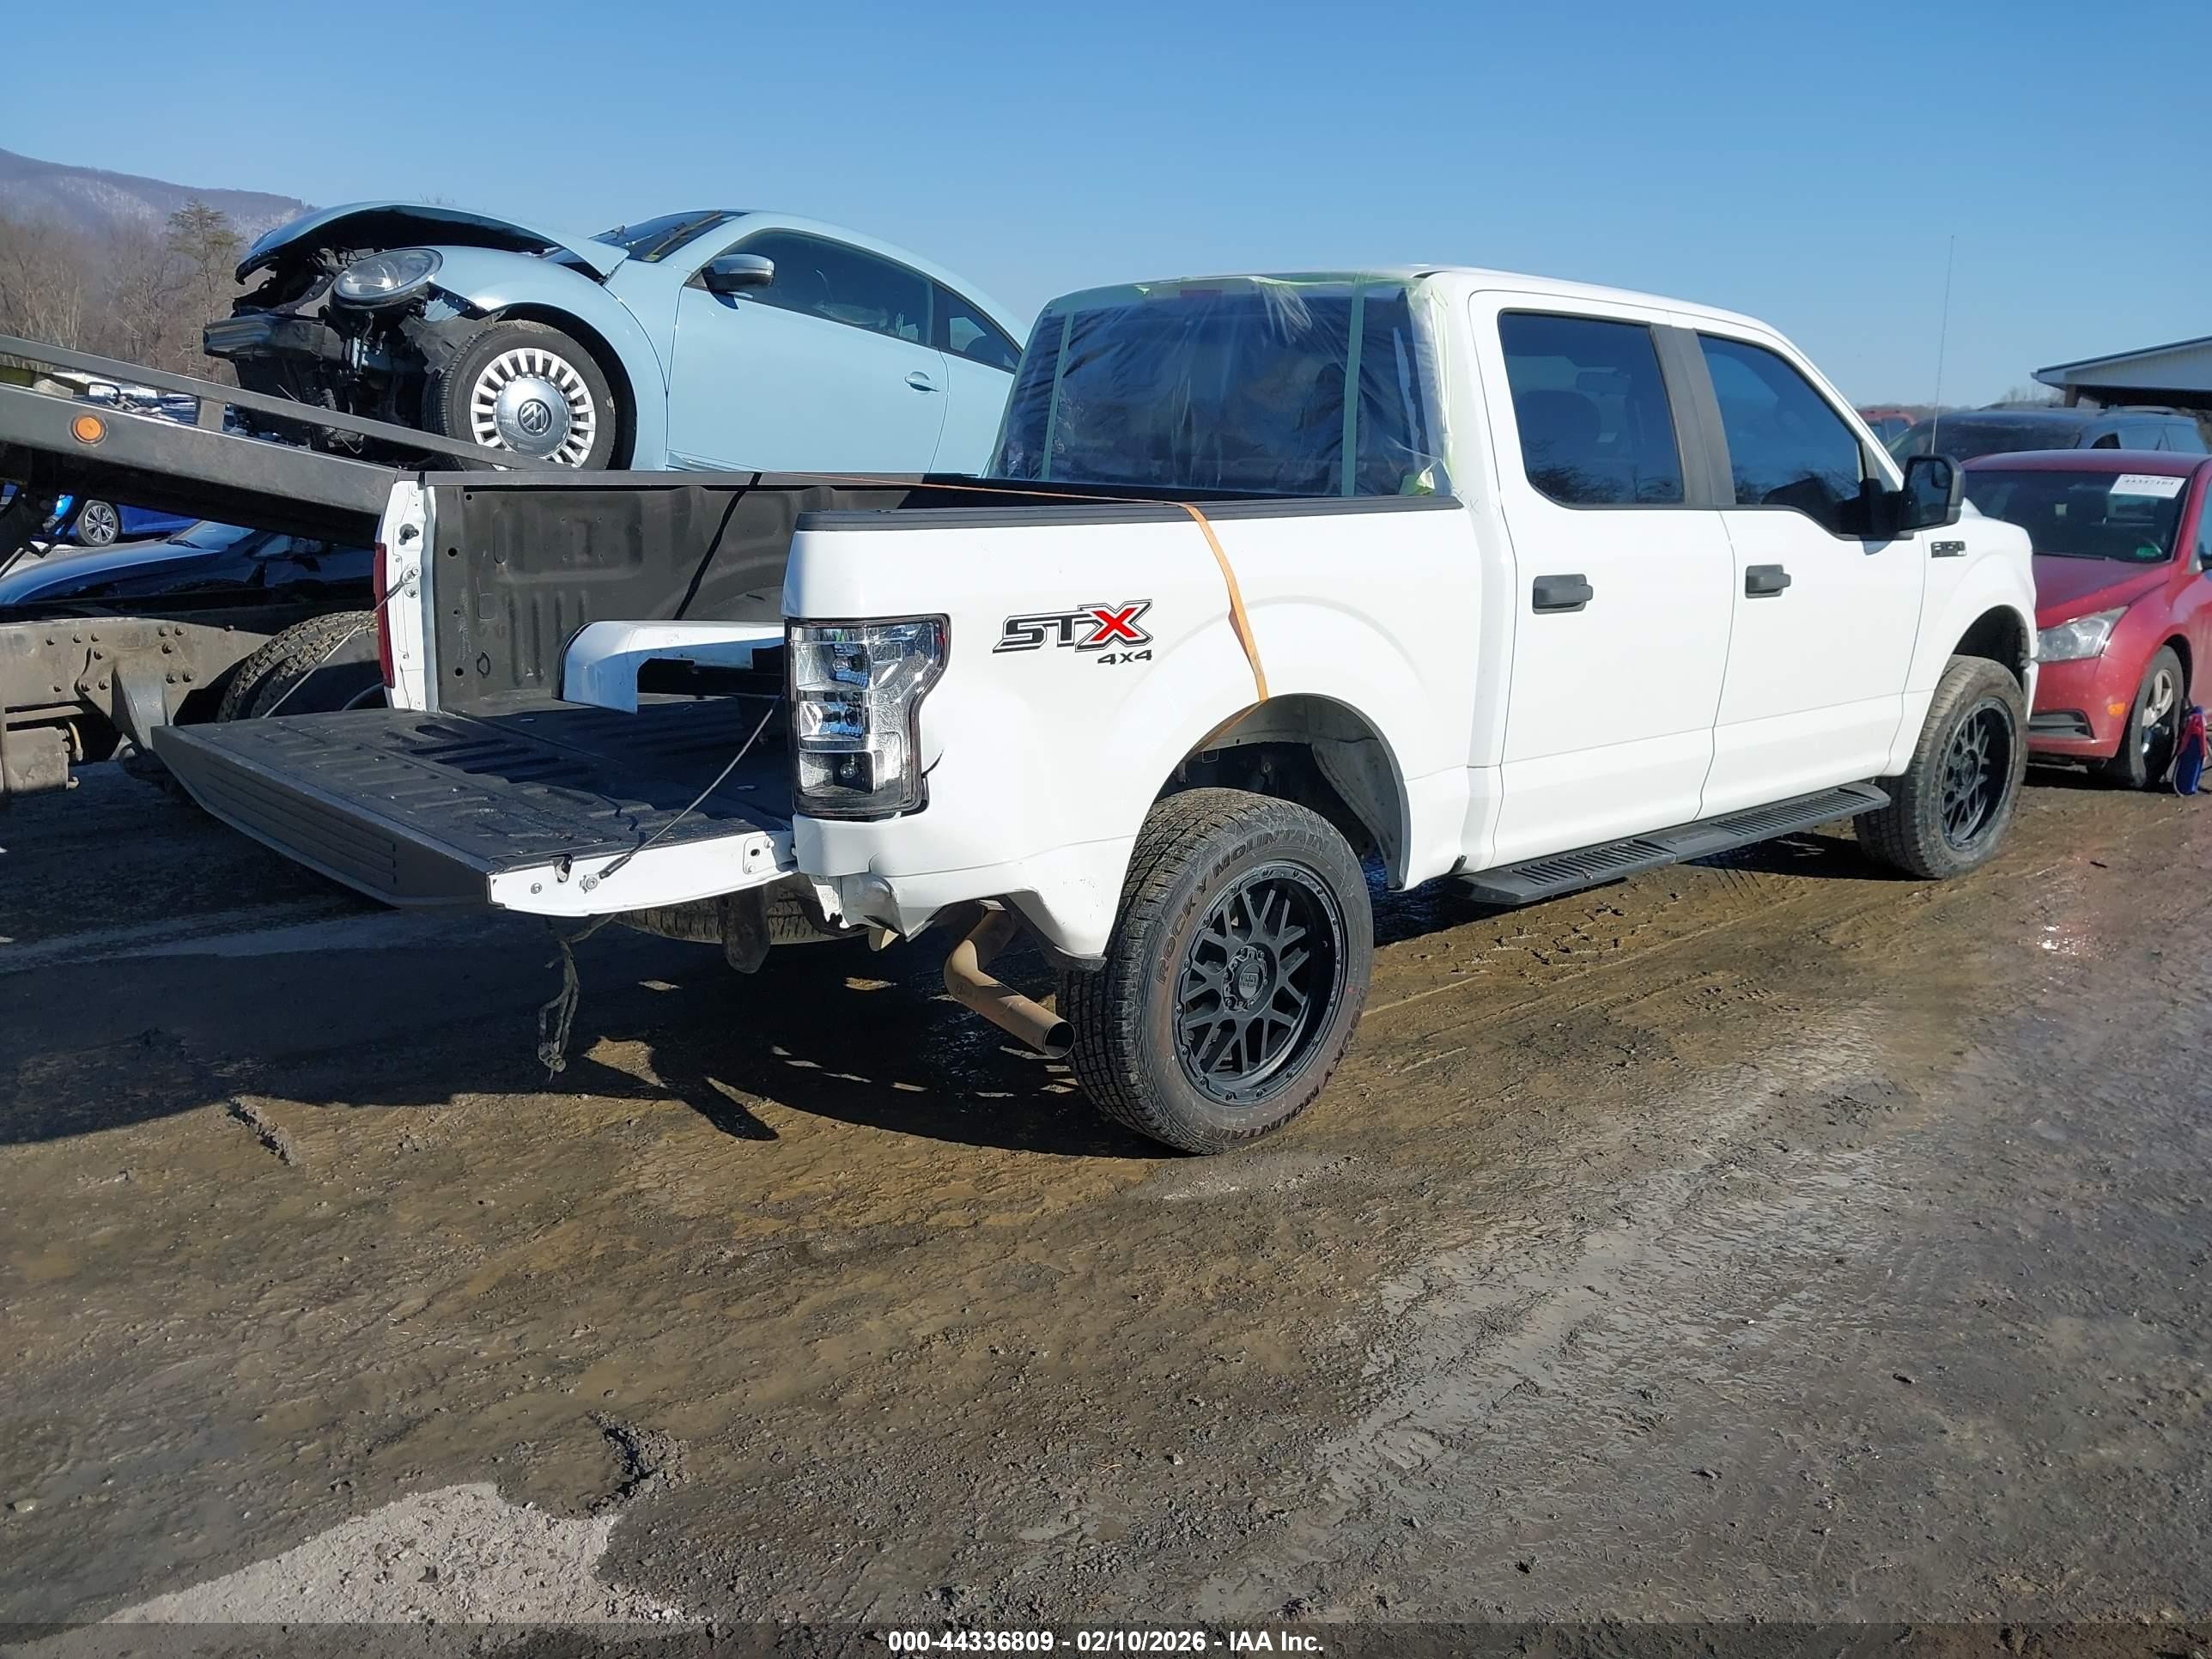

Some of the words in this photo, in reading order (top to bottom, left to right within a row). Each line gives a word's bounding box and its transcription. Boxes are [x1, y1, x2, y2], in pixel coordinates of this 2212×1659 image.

[993, 599, 1154, 653] STX
[1156, 873, 1208, 984] ROCKY
[1211, 829, 1330, 879] MOUNTAIN
